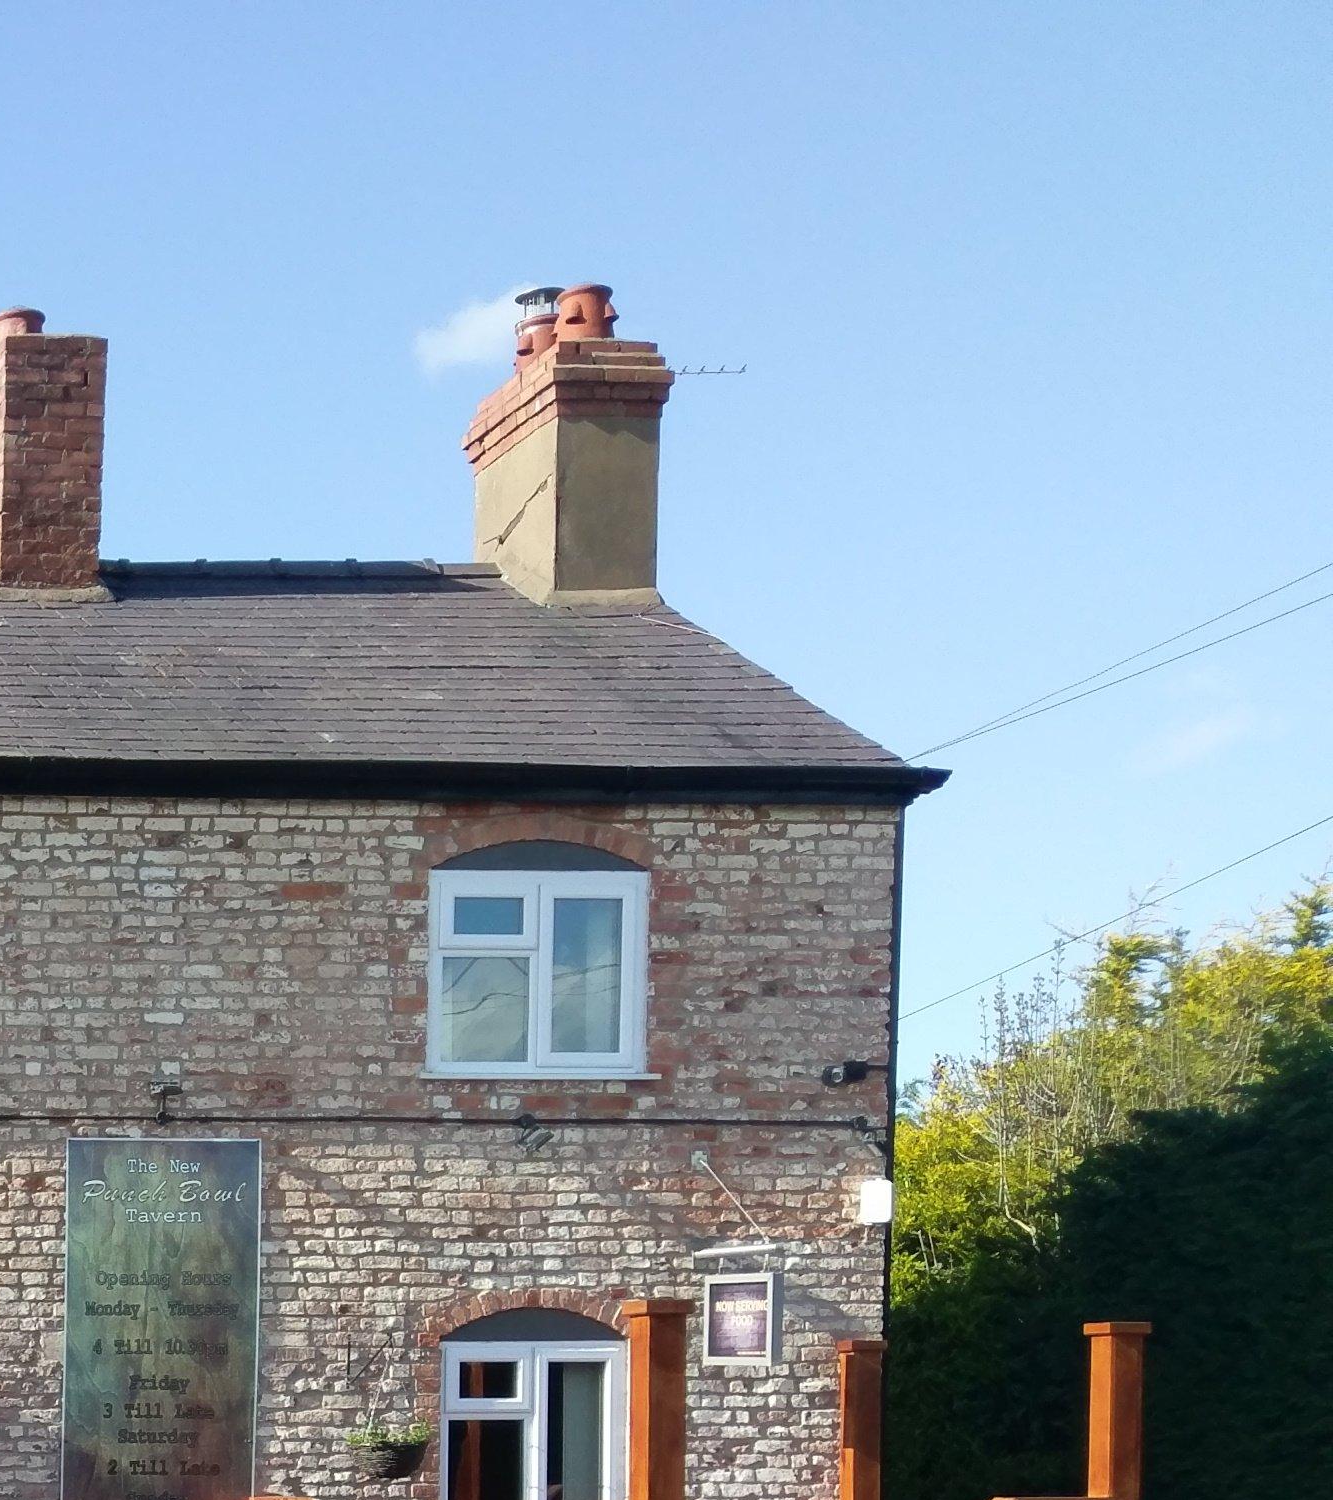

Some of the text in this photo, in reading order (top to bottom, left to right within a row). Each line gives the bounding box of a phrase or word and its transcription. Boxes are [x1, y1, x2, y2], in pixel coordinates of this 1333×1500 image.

[127, 1159, 201, 1173] The New
[82, 1179, 247, 1203] Punch Bowl
[125, 1209, 202, 1223] Tavern
[95, 1271, 232, 1290] Opening Hours
[85, 1300, 141, 1320] Monday
[114, 1338, 153, 1355] Till
[129, 1374, 191, 1395] Friday
[123, 1402, 164, 1420] Till
[117, 1428, 200, 1448] Saturday
[107, 1459, 118, 1476] 2
[129, 1459, 168, 1476] Till
